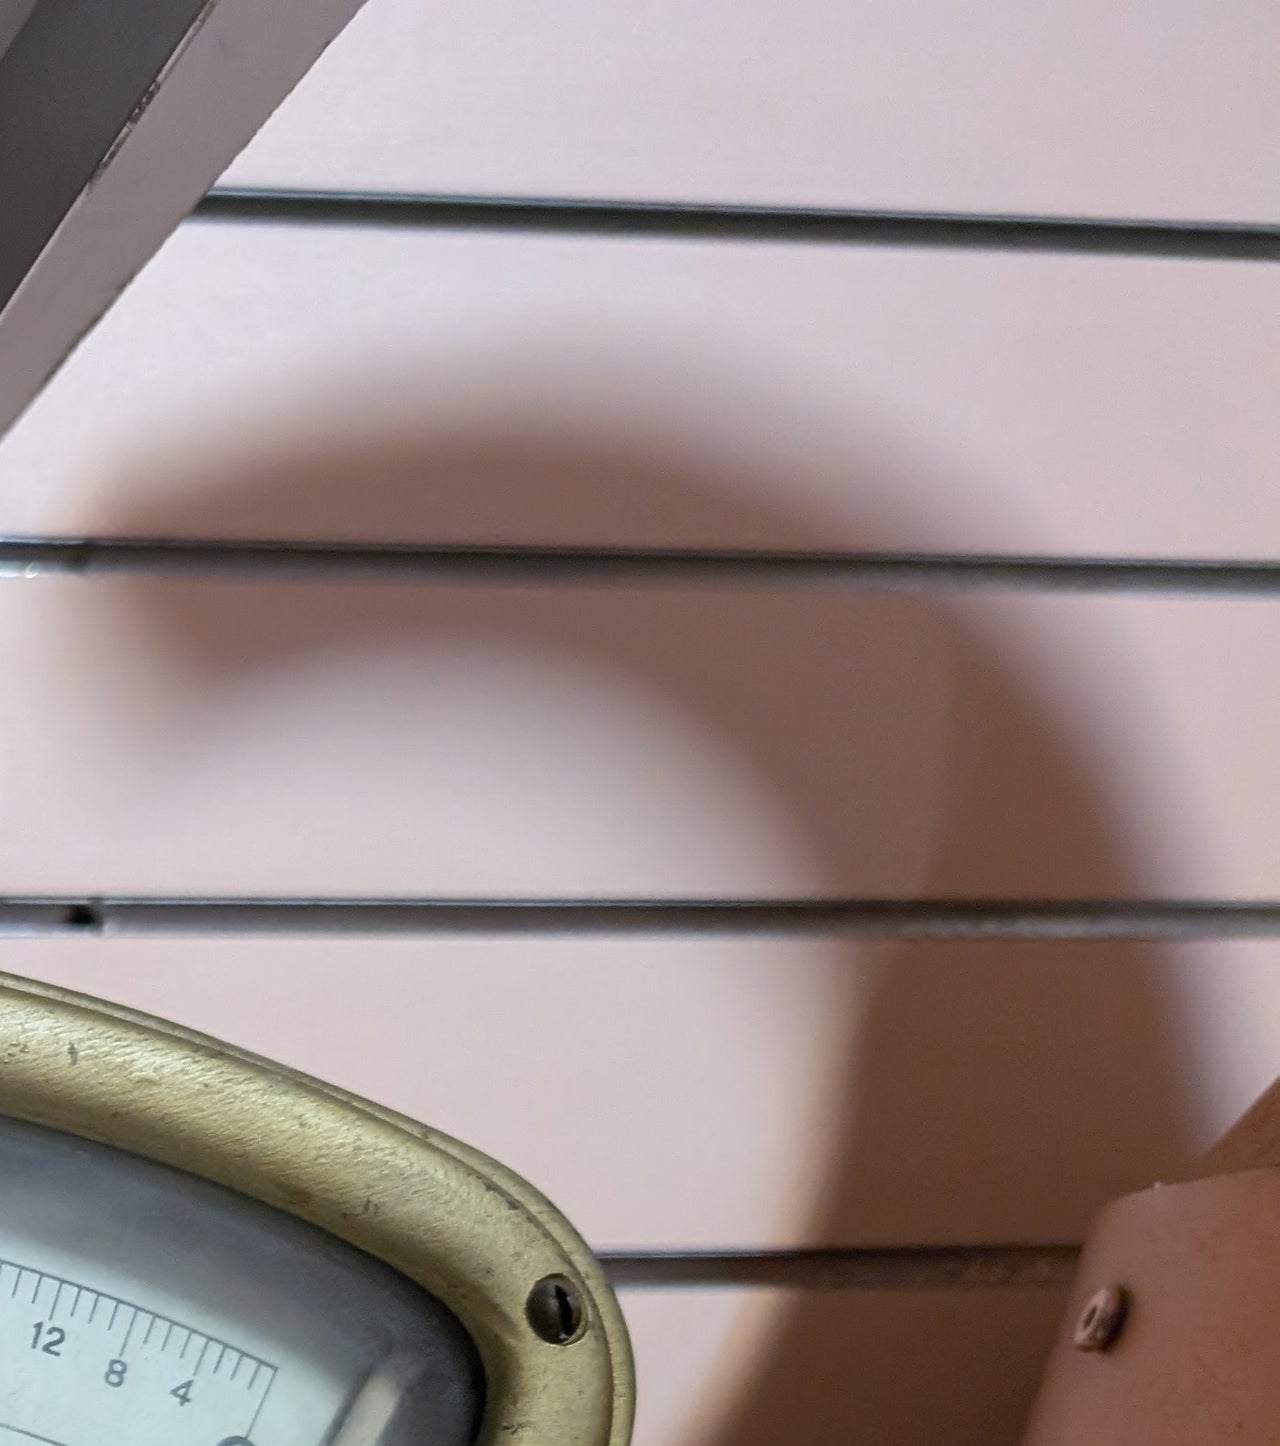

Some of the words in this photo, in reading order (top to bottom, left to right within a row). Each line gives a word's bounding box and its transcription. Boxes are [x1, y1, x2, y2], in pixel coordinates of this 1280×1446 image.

[31, 1322, 67, 1357] 12
[103, 1359, 127, 1388] 8
[170, 1379, 193, 1407] 4
